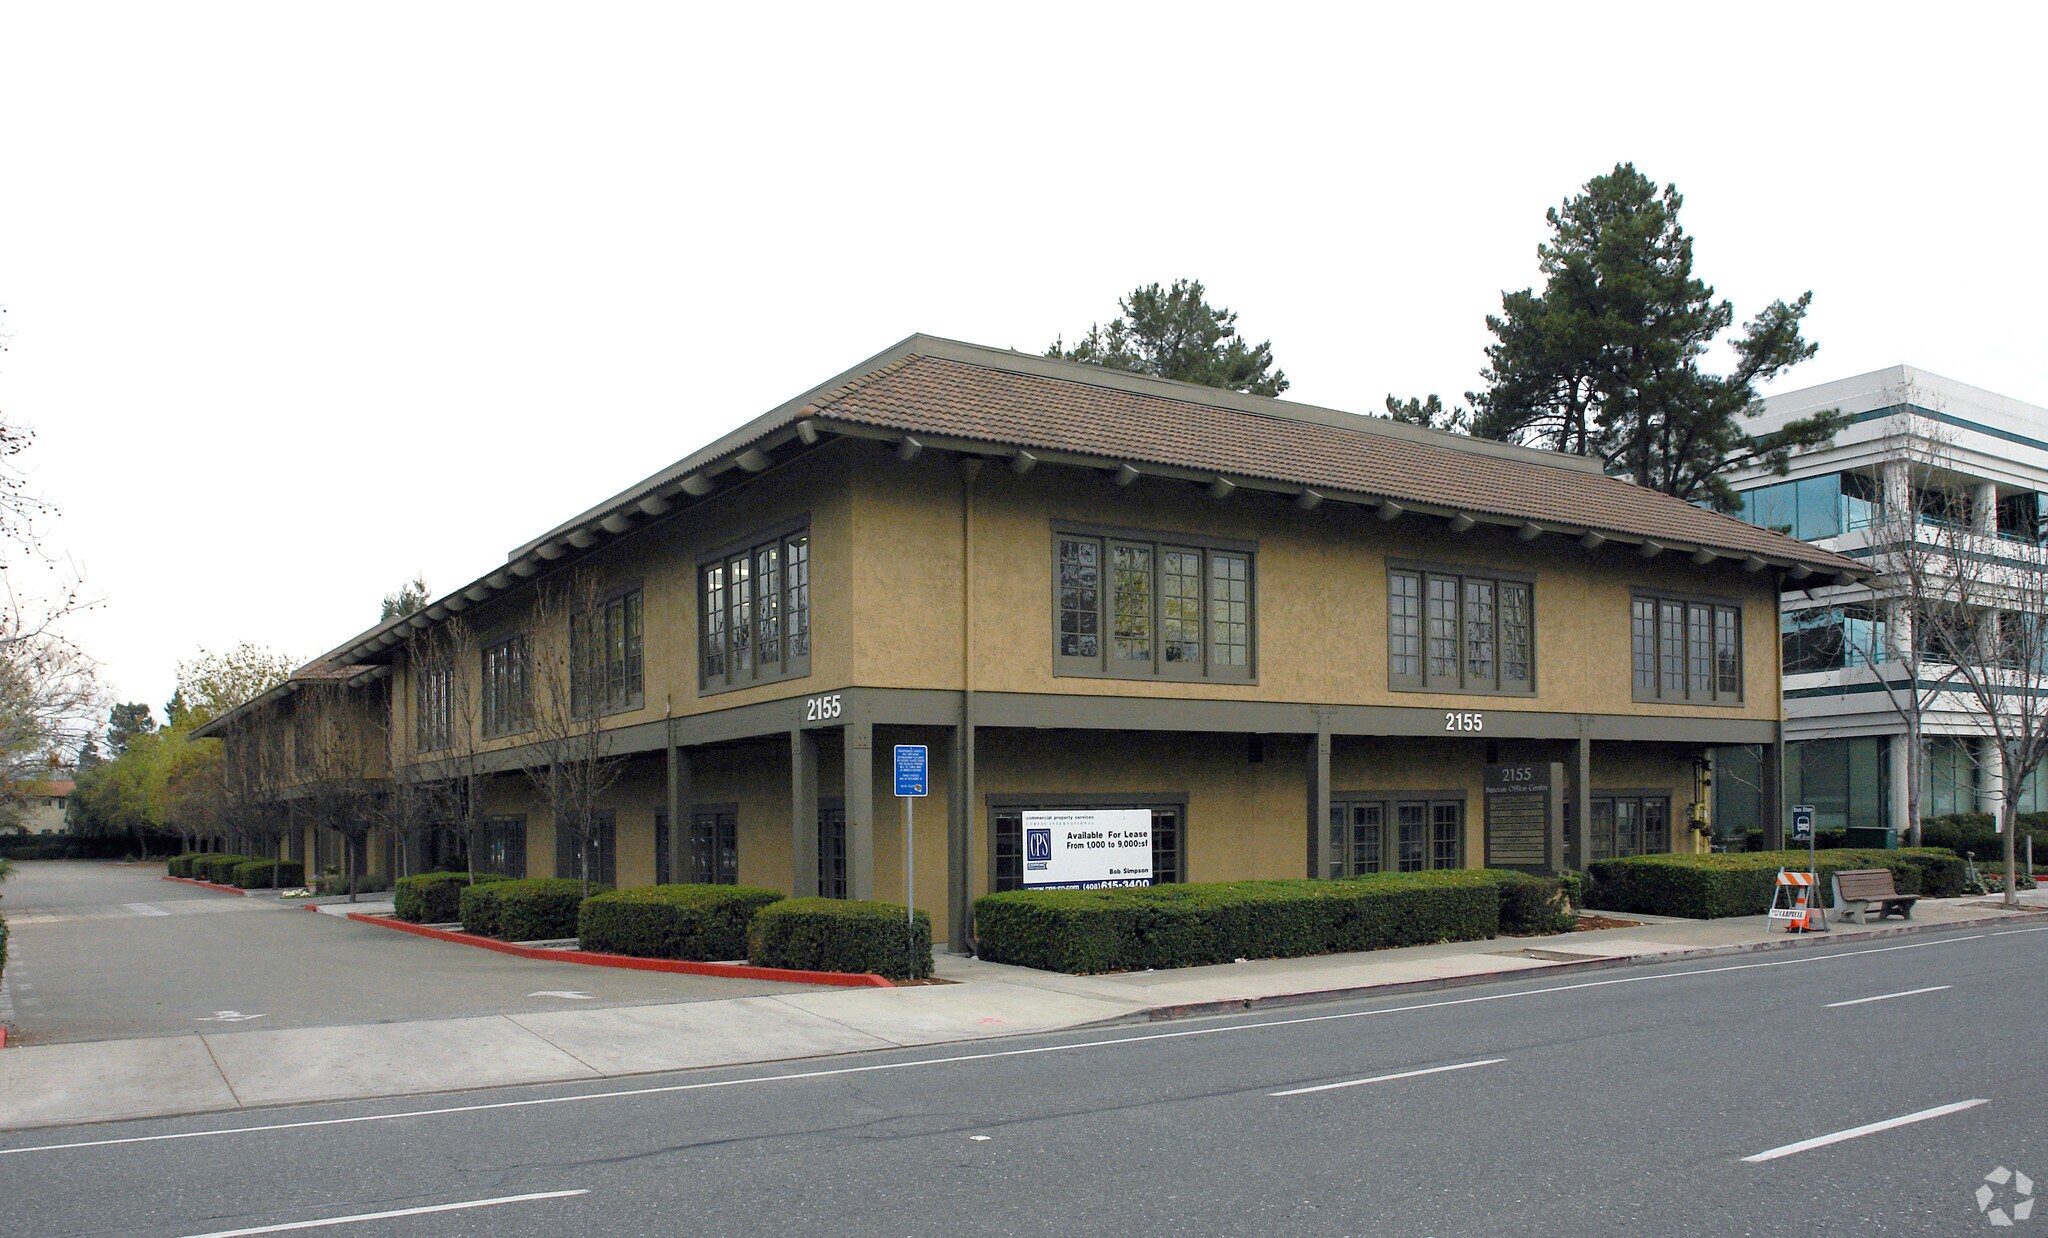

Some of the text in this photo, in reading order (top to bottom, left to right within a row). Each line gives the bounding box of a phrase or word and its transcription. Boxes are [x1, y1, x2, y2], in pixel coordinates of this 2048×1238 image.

[807, 695, 841, 721] 2155
[1445, 712, 1483, 732] 2155
[1502, 767, 1532, 782] 2155
[1508, 784, 1528, 792] Office
[1528, 784, 1549, 792] Center
[1067, 830, 1148, 840] Available For Lease
[1030, 833, 1048, 857] CPS
[1066, 841, 1084, 850] From
[1086, 841, 1106, 850] 1,000
[1123, 867, 1149, 875] Simpson
[1101, 880, 1149, 889] 615-3400
